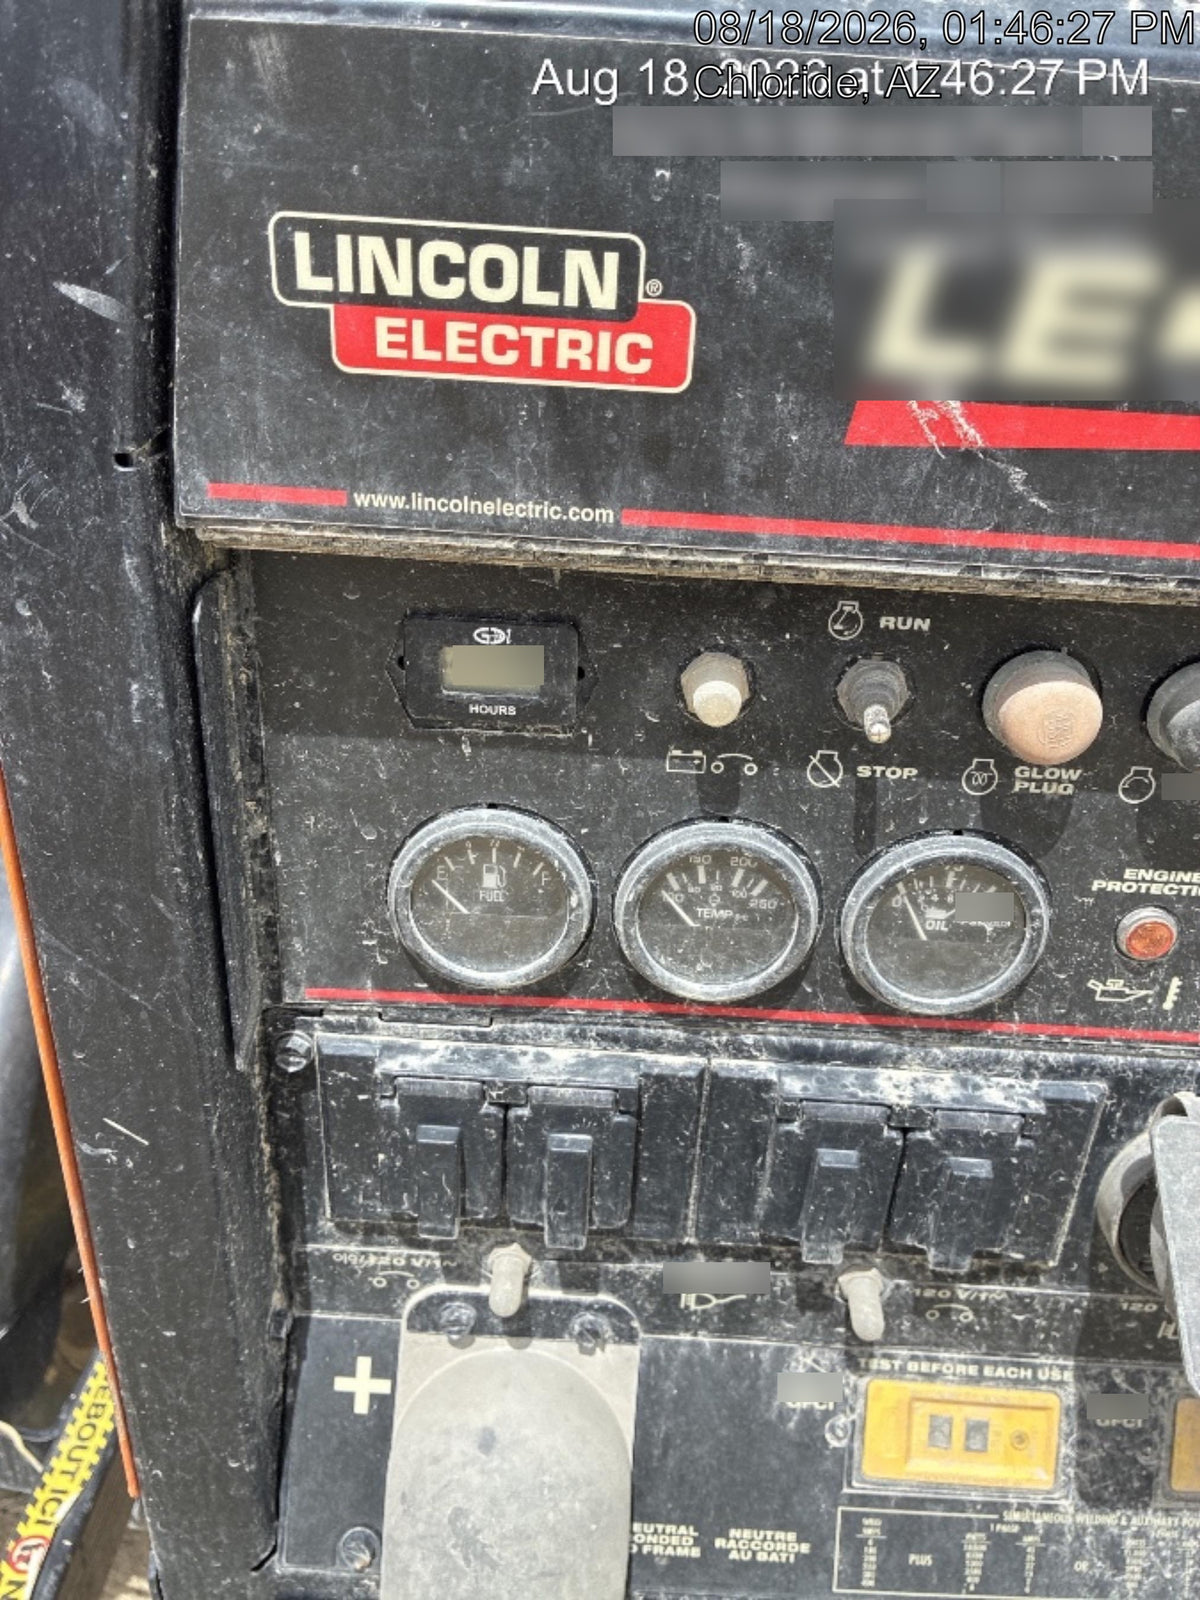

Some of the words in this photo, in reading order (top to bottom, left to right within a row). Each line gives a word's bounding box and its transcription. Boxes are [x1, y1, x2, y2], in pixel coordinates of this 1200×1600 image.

[292, 231, 620, 311] LINCOLN
[374, 315, 654, 376] ELECTRIC
[353, 488, 615, 525] www.lincolnelectric.com
[879, 616, 932, 632] RUN
[469, 703, 517, 717] HOURS
[856, 765, 919, 780] STOP
[1014, 765, 1082, 782] GLOW
[1013, 780, 1075, 796] PLUG
[437, 865, 449, 881] E
[541, 870, 551, 886] F
[1123, 868, 1200, 883] ENGINE
[480, 890, 505, 902] FUEL
[697, 908, 733, 919] TEMP
[926, 920, 949, 931] OIL
[1121, 1302, 1158, 1312] 120
[860, 1359, 901, 1371] TEST
[906, 1360, 979, 1376] BEFORE
[983, 1365, 1033, 1380] EACH
[1037, 1366, 1075, 1382] USE
[632, 1522, 699, 1537] EUTRAL
[729, 1528, 797, 1543] NEUTRE
[632, 1534, 694, 1547] ONDED
[642, 1544, 701, 1558] FRAME
[729, 1549, 752, 1561] AU
[908, 1553, 933, 1566] PLUS
